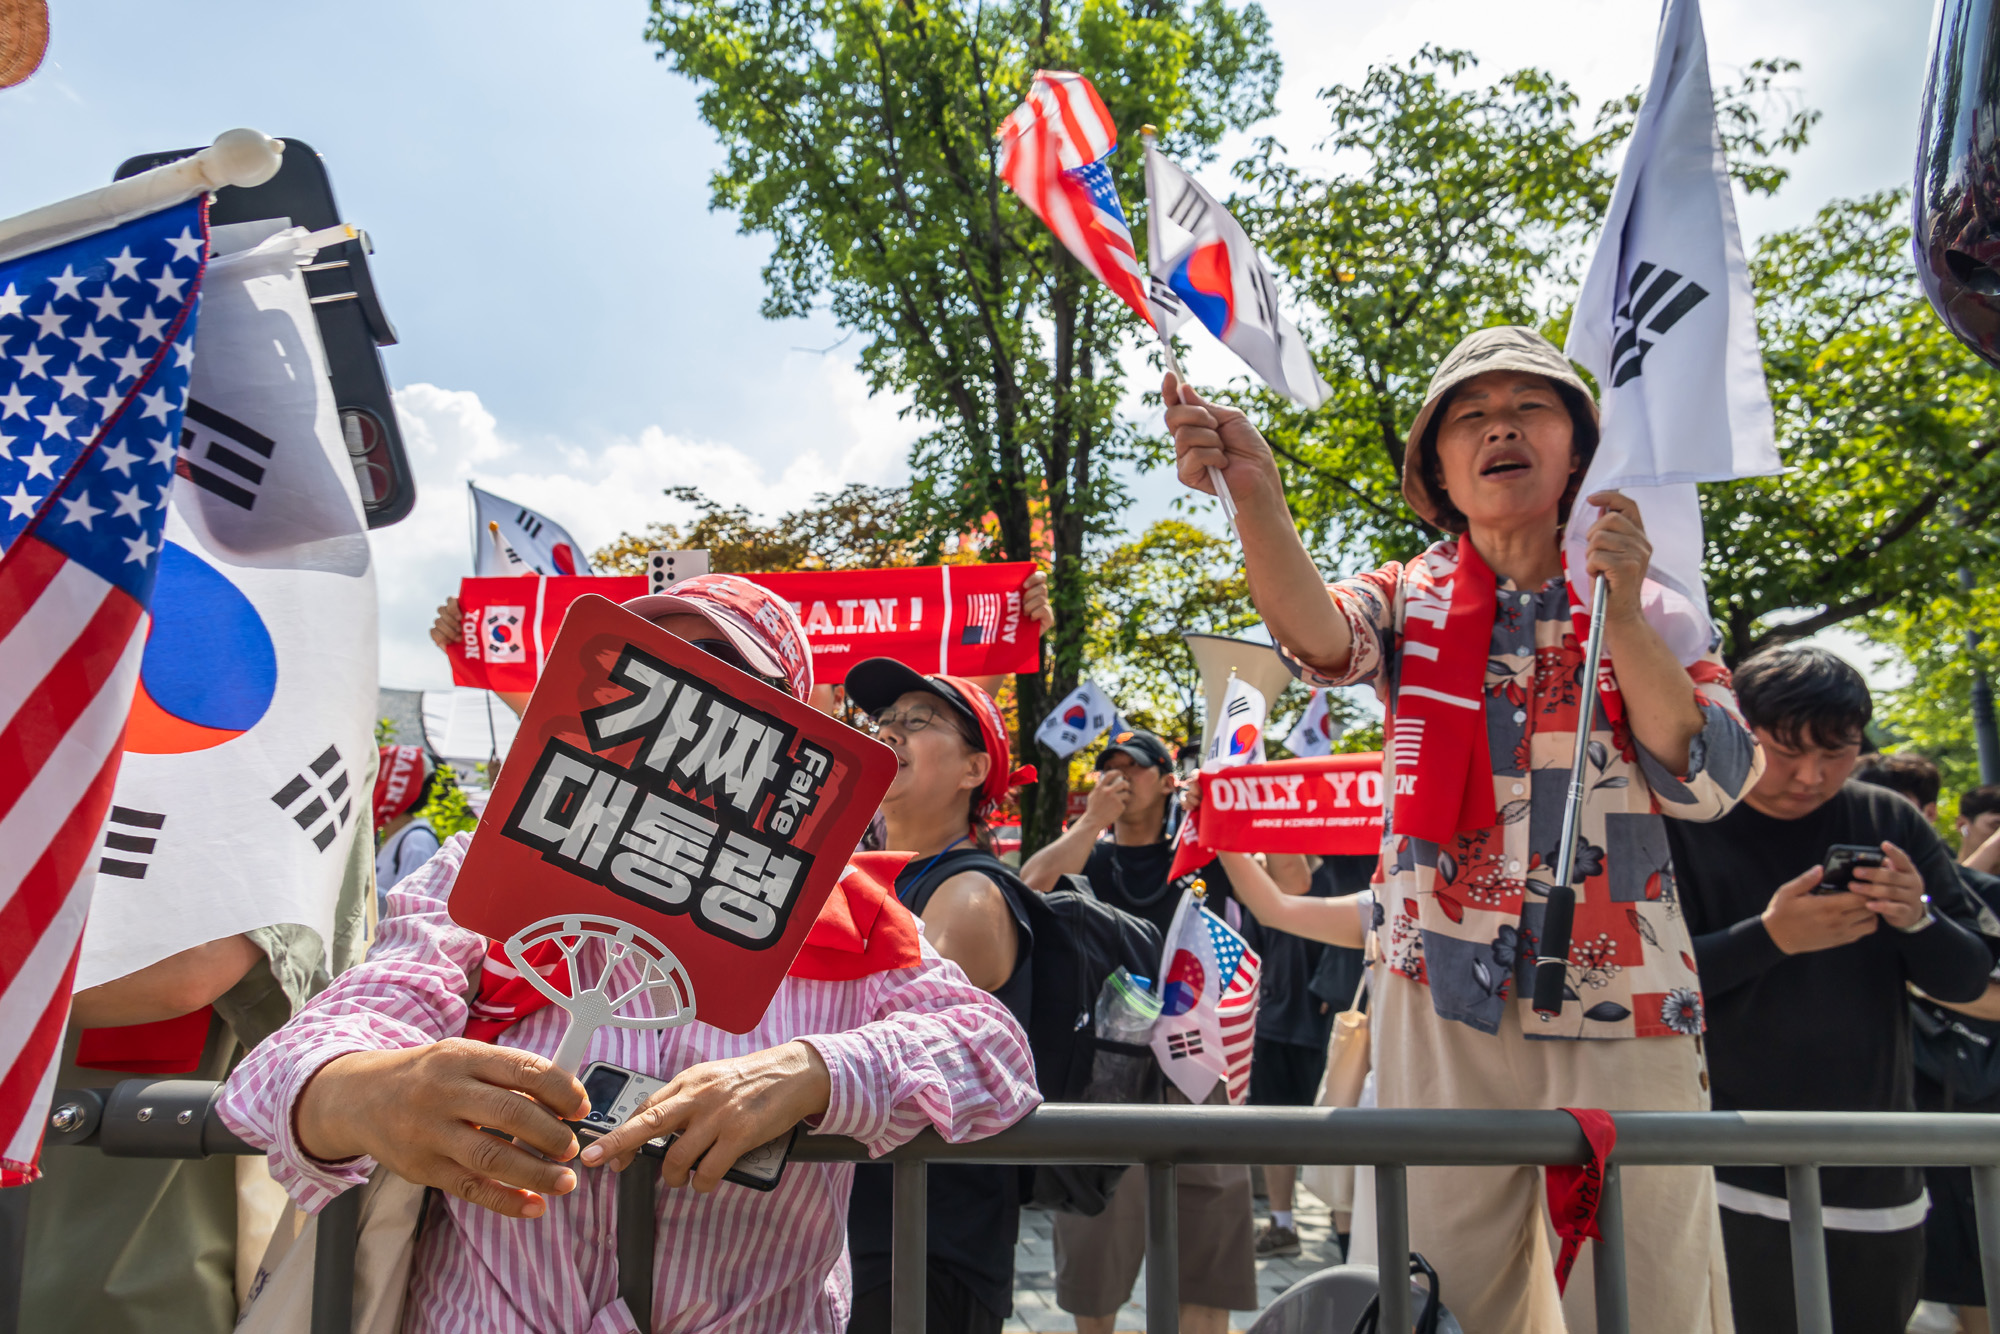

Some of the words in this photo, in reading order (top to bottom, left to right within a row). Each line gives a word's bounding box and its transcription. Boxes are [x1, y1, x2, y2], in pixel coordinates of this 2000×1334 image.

[463, 609, 481, 660] YOON
[1001, 590, 1020, 645] AGAIN
[595, 657, 784, 813] 가짜
[770, 747, 828, 835] Fake
[517, 752, 803, 940] 대통령
